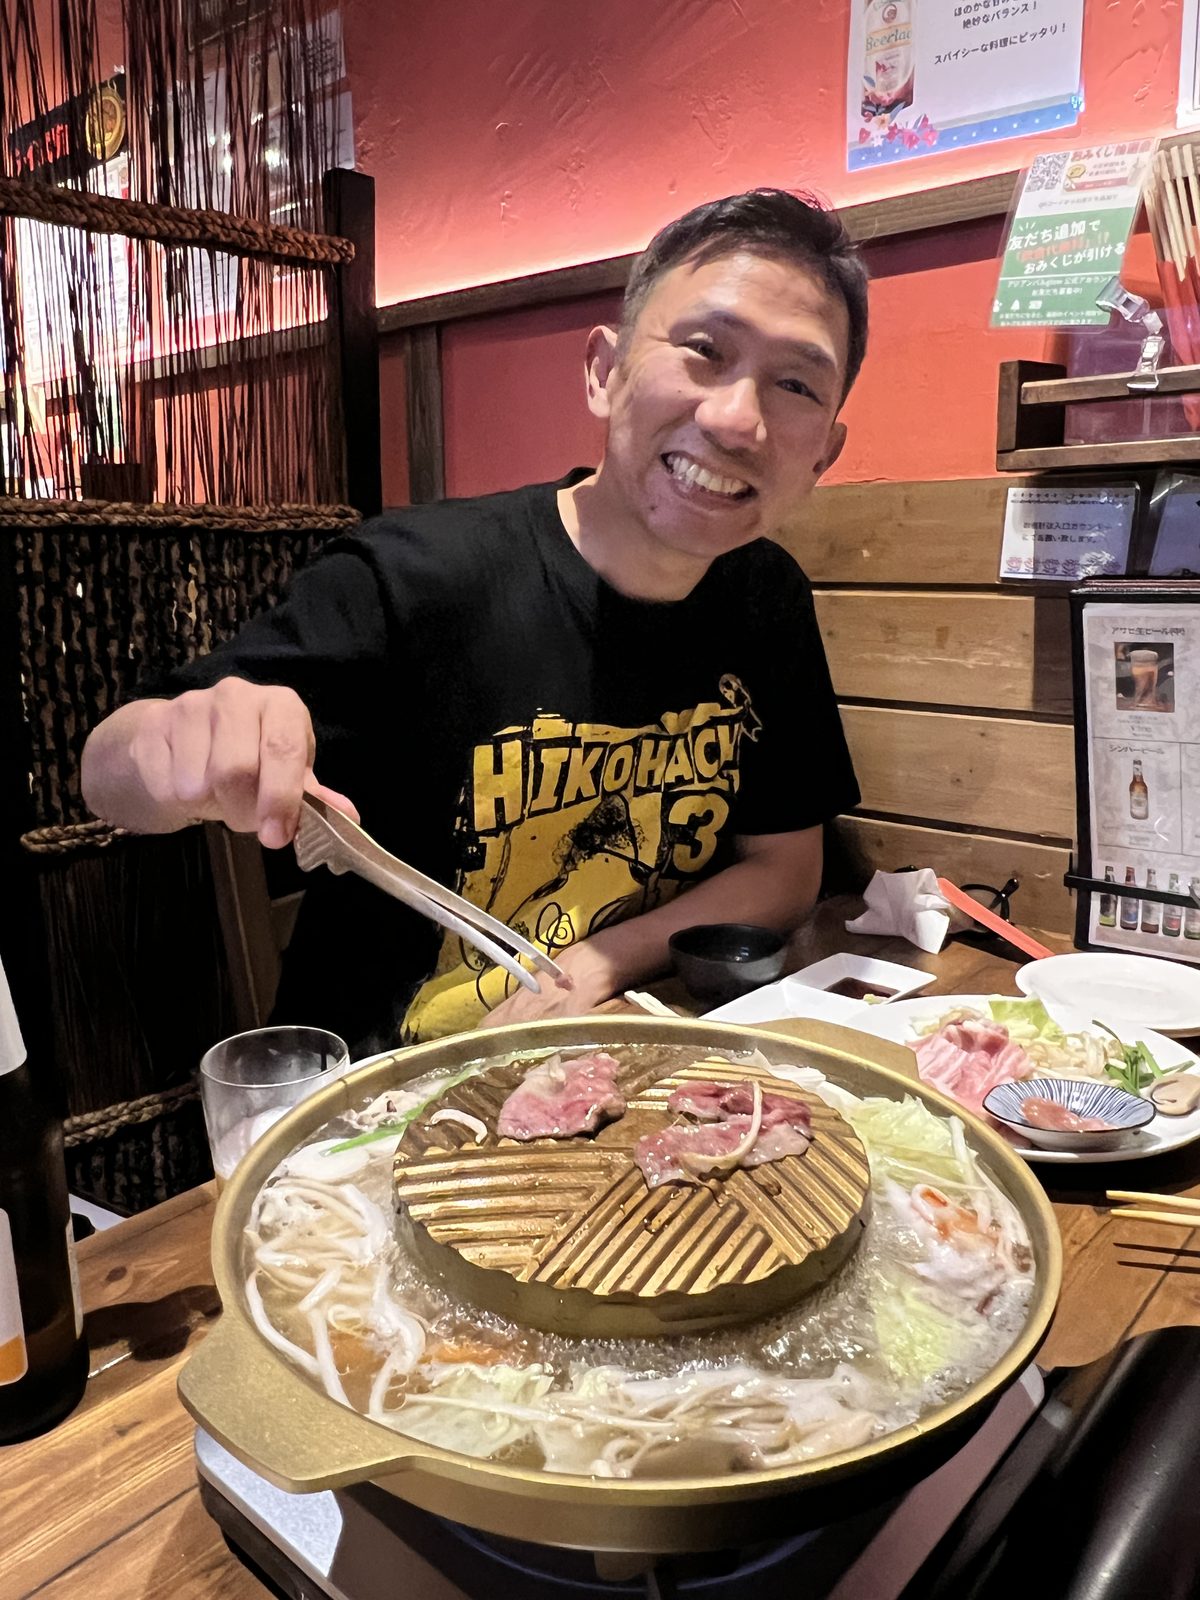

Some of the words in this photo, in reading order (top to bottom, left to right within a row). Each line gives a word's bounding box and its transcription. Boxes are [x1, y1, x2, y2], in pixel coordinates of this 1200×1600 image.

[1008, 220, 1100, 251] 友だち追加で
[1024, 242, 1125, 275] おみくじが引ける
